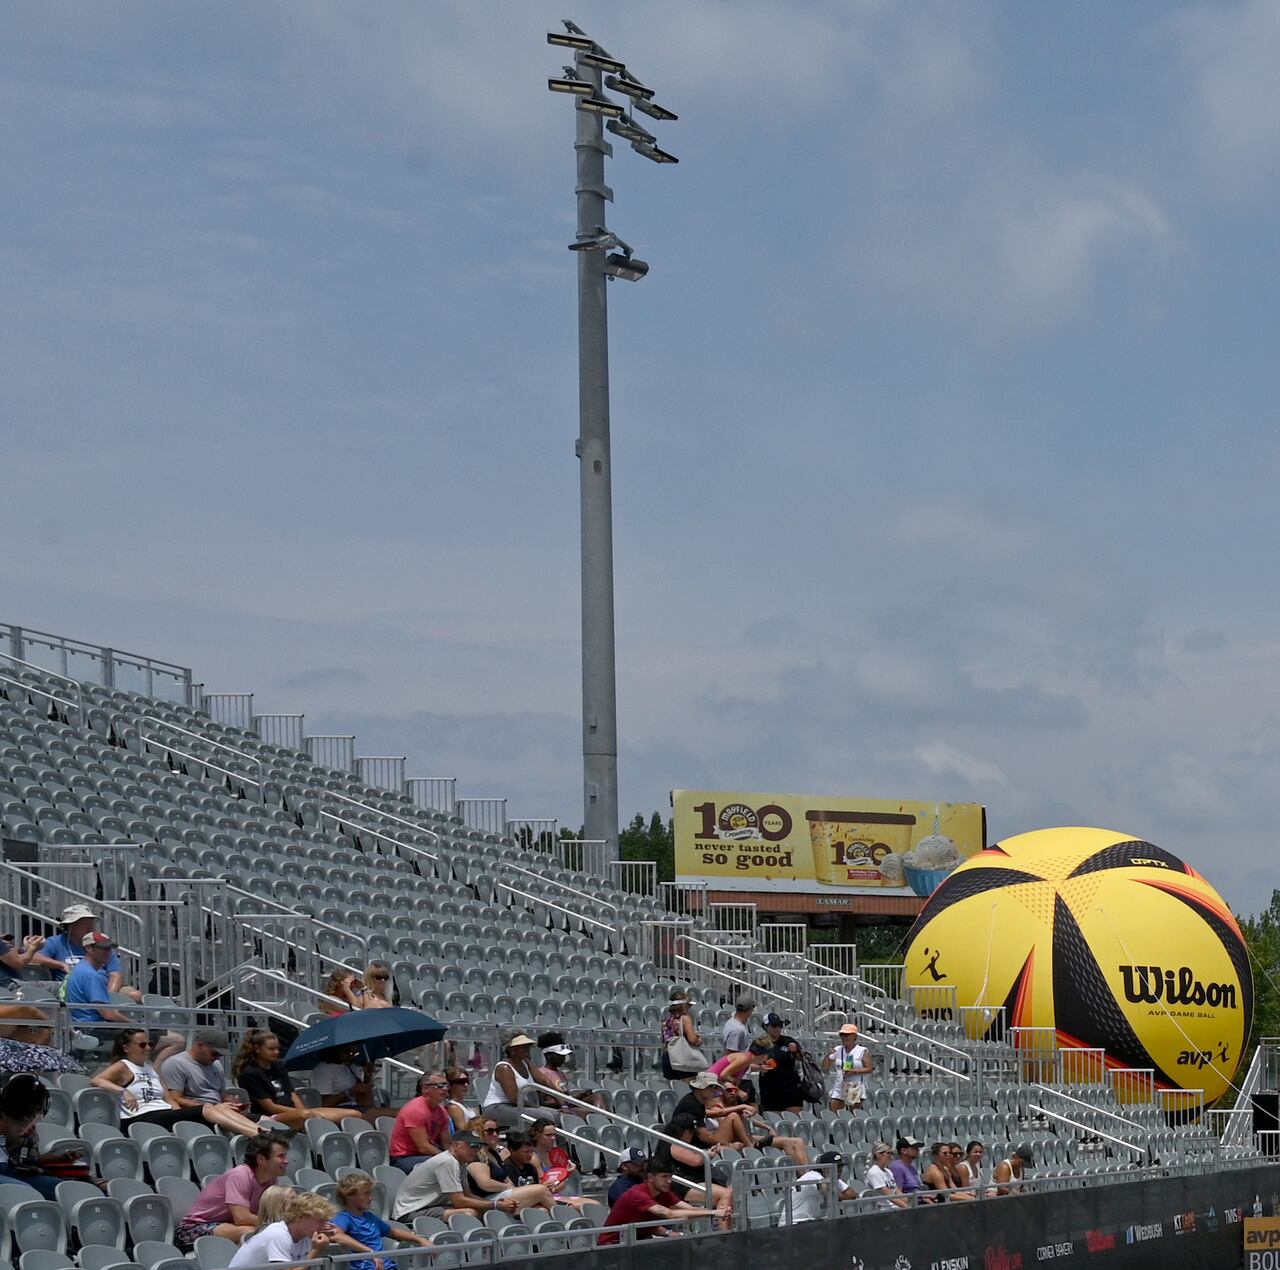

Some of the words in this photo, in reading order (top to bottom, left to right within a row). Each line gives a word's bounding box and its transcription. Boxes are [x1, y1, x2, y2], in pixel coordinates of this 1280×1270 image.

[721, 805, 756, 822] MAYFIELD
[694, 843, 734, 851] never
[739, 844, 780, 853] tasted
[702, 853, 728, 865] so
[736, 851, 793, 870] good
[1119, 966, 1237, 1009] Wilson
[1177, 1050, 1212, 1070] avp
[1246, 1228, 1280, 1247] avp
